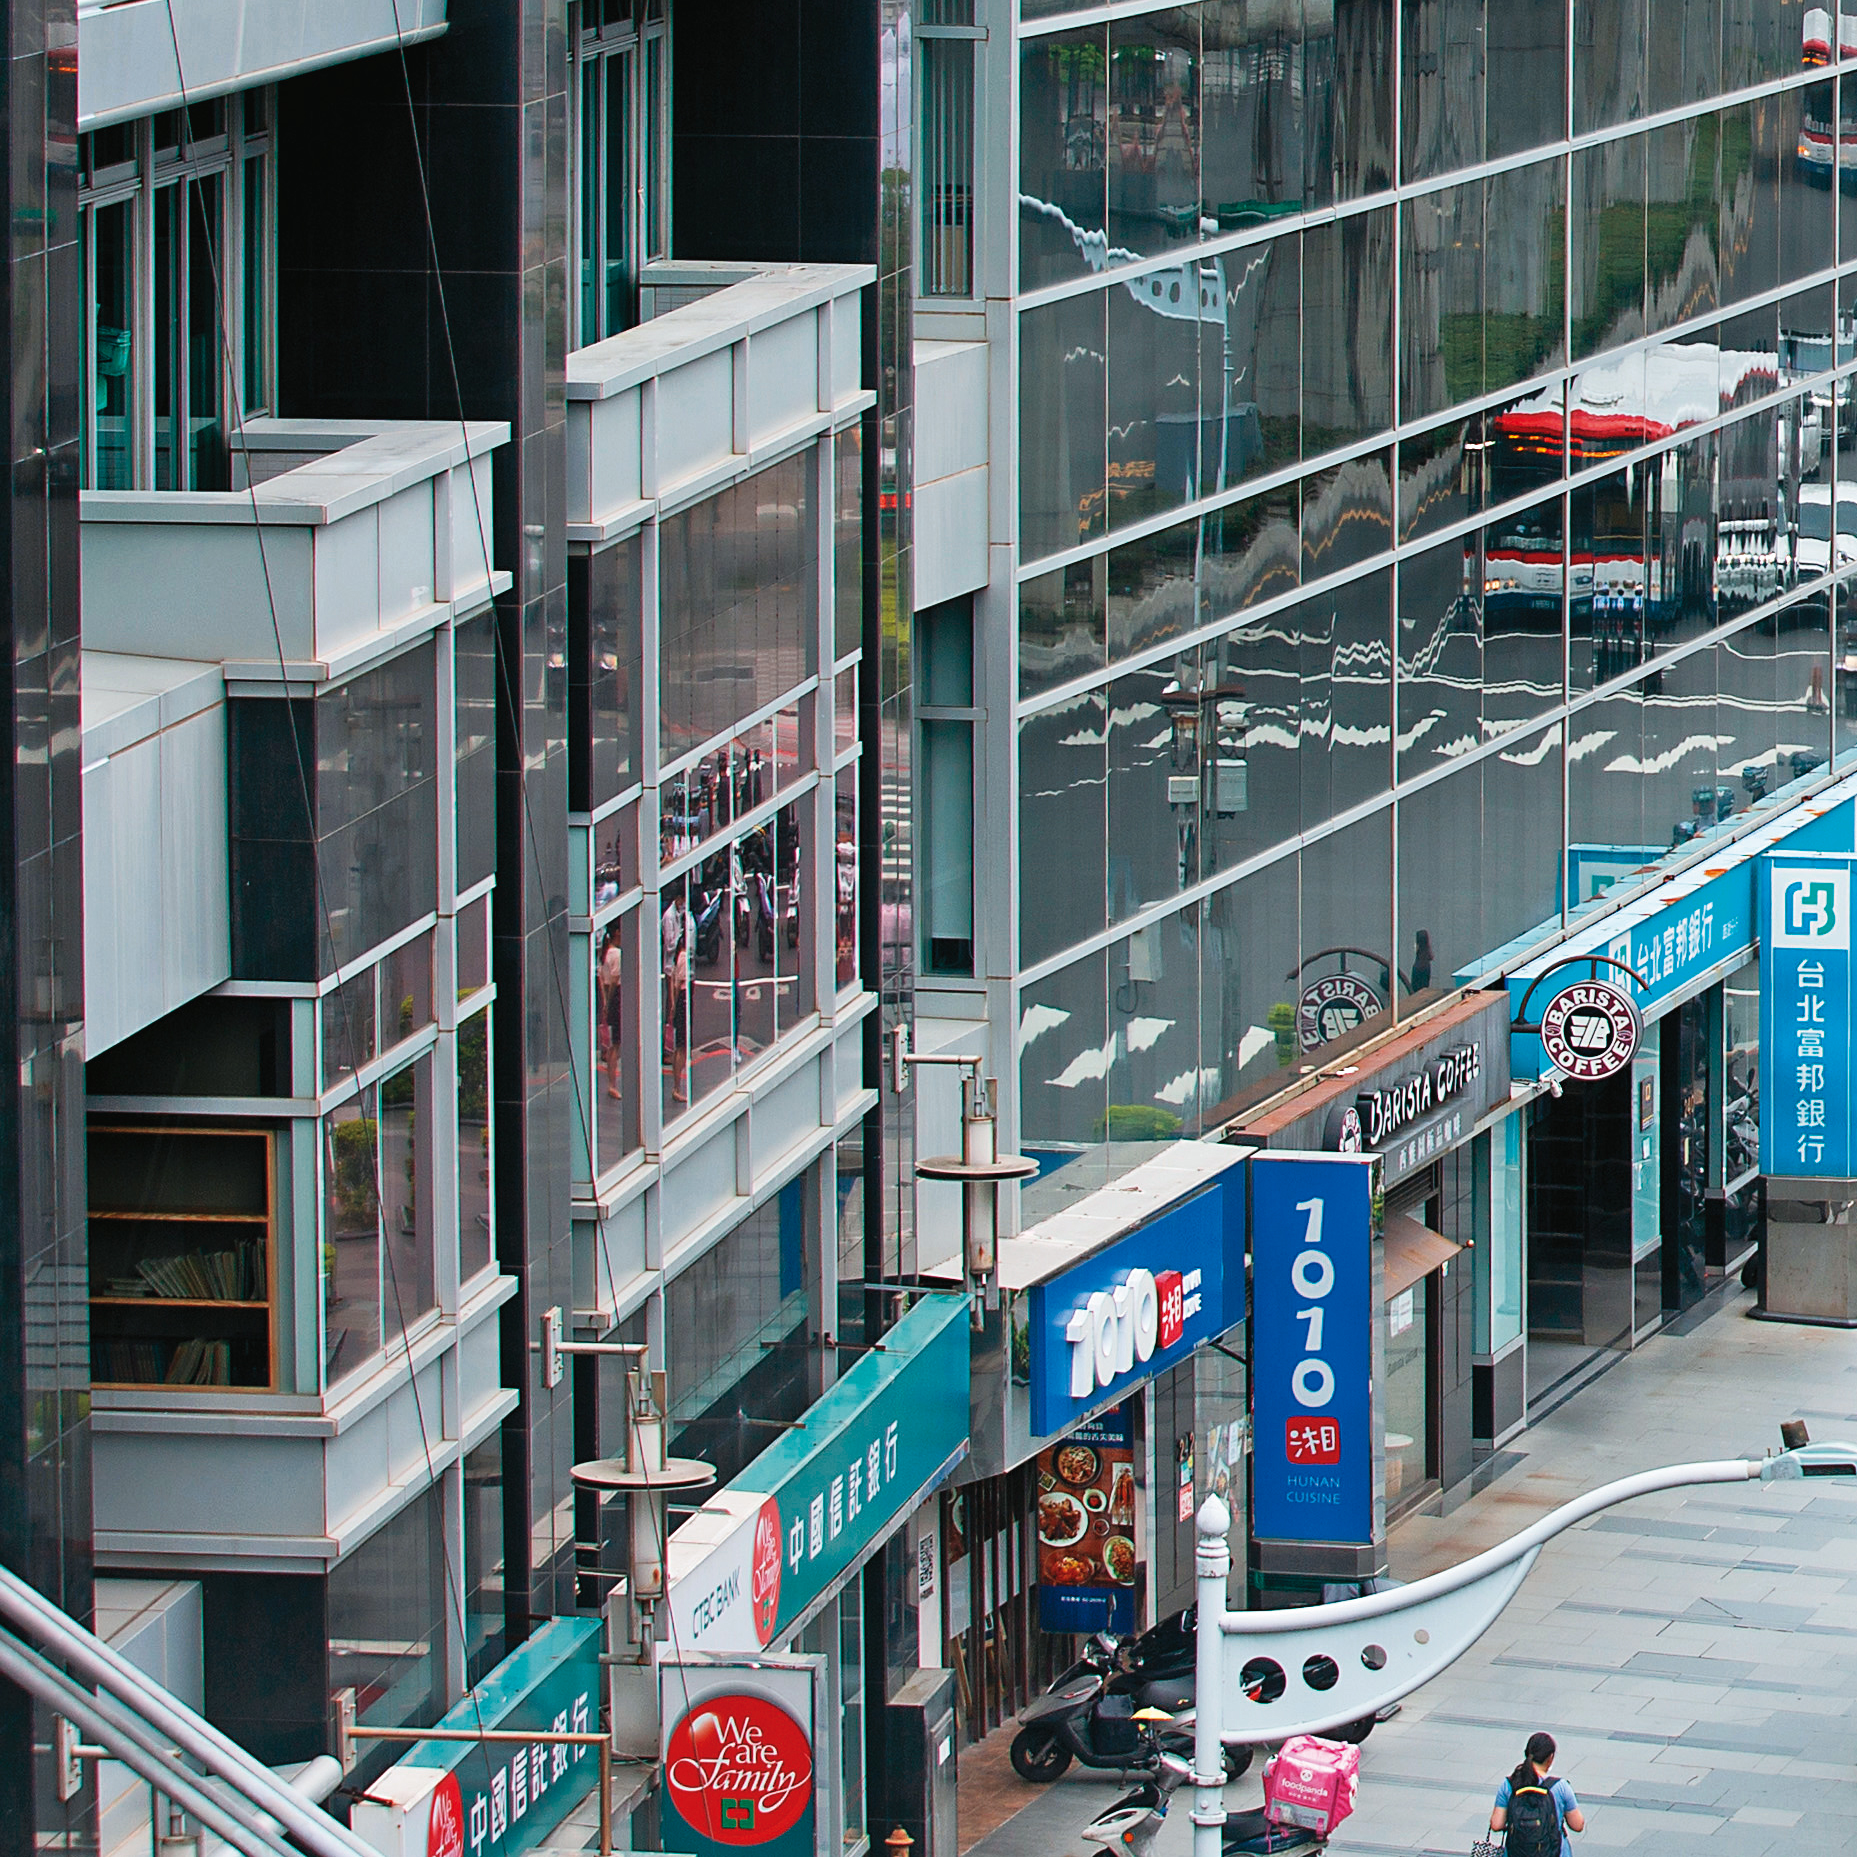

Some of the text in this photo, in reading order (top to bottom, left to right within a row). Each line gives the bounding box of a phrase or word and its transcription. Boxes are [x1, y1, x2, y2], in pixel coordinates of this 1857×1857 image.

[1637, 901, 1714, 994] 台北富邦銀行
[1547, 988, 1631, 1031] BARISTA
[1548, 1037, 1630, 1075] COFFEE
[1796, 959, 1826, 1164] 台北富邦銀行
[1370, 1070, 1432, 1146] BARISTA
[1436, 1042, 1480, 1103] COFFEE
[1065, 1267, 1158, 1399] 1010
[1161, 1284, 1182, 1340] 湘
[1290, 1196, 1337, 1409] 1010
[1288, 1422, 1337, 1459] 湘
[789, 1419, 898, 1575] 中國信託銀行
[1286, 1490, 1341, 1505] CUISINE
[1287, 1474, 1340, 1488] HUNAN
[693, 1565, 741, 1639] CTBC BANK
[694, 1713, 763, 1745] We
[470, 1691, 589, 1857] 中國信託銀行
[1281, 1777, 1328, 1798] foodpanda
